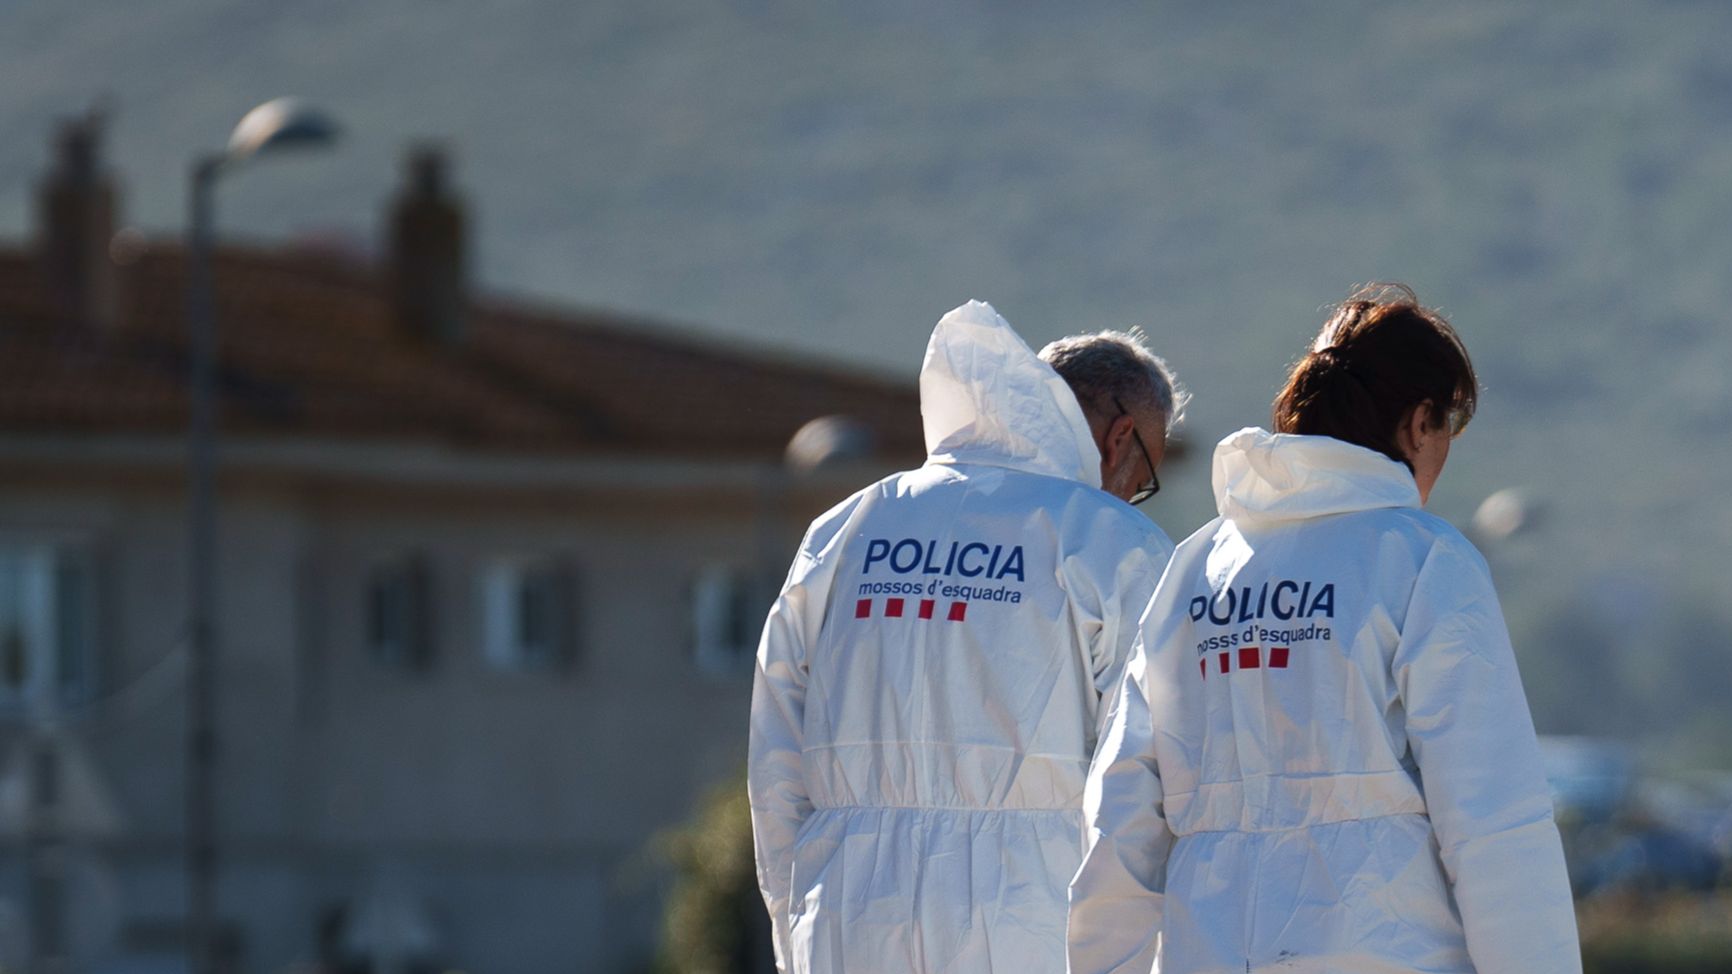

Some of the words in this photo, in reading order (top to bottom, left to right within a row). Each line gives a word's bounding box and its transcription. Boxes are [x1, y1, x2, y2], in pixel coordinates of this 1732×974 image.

[862, 538, 1025, 582] POLICIA
[858, 580, 923, 596] mossos
[1189, 580, 1335, 626] POLICIA
